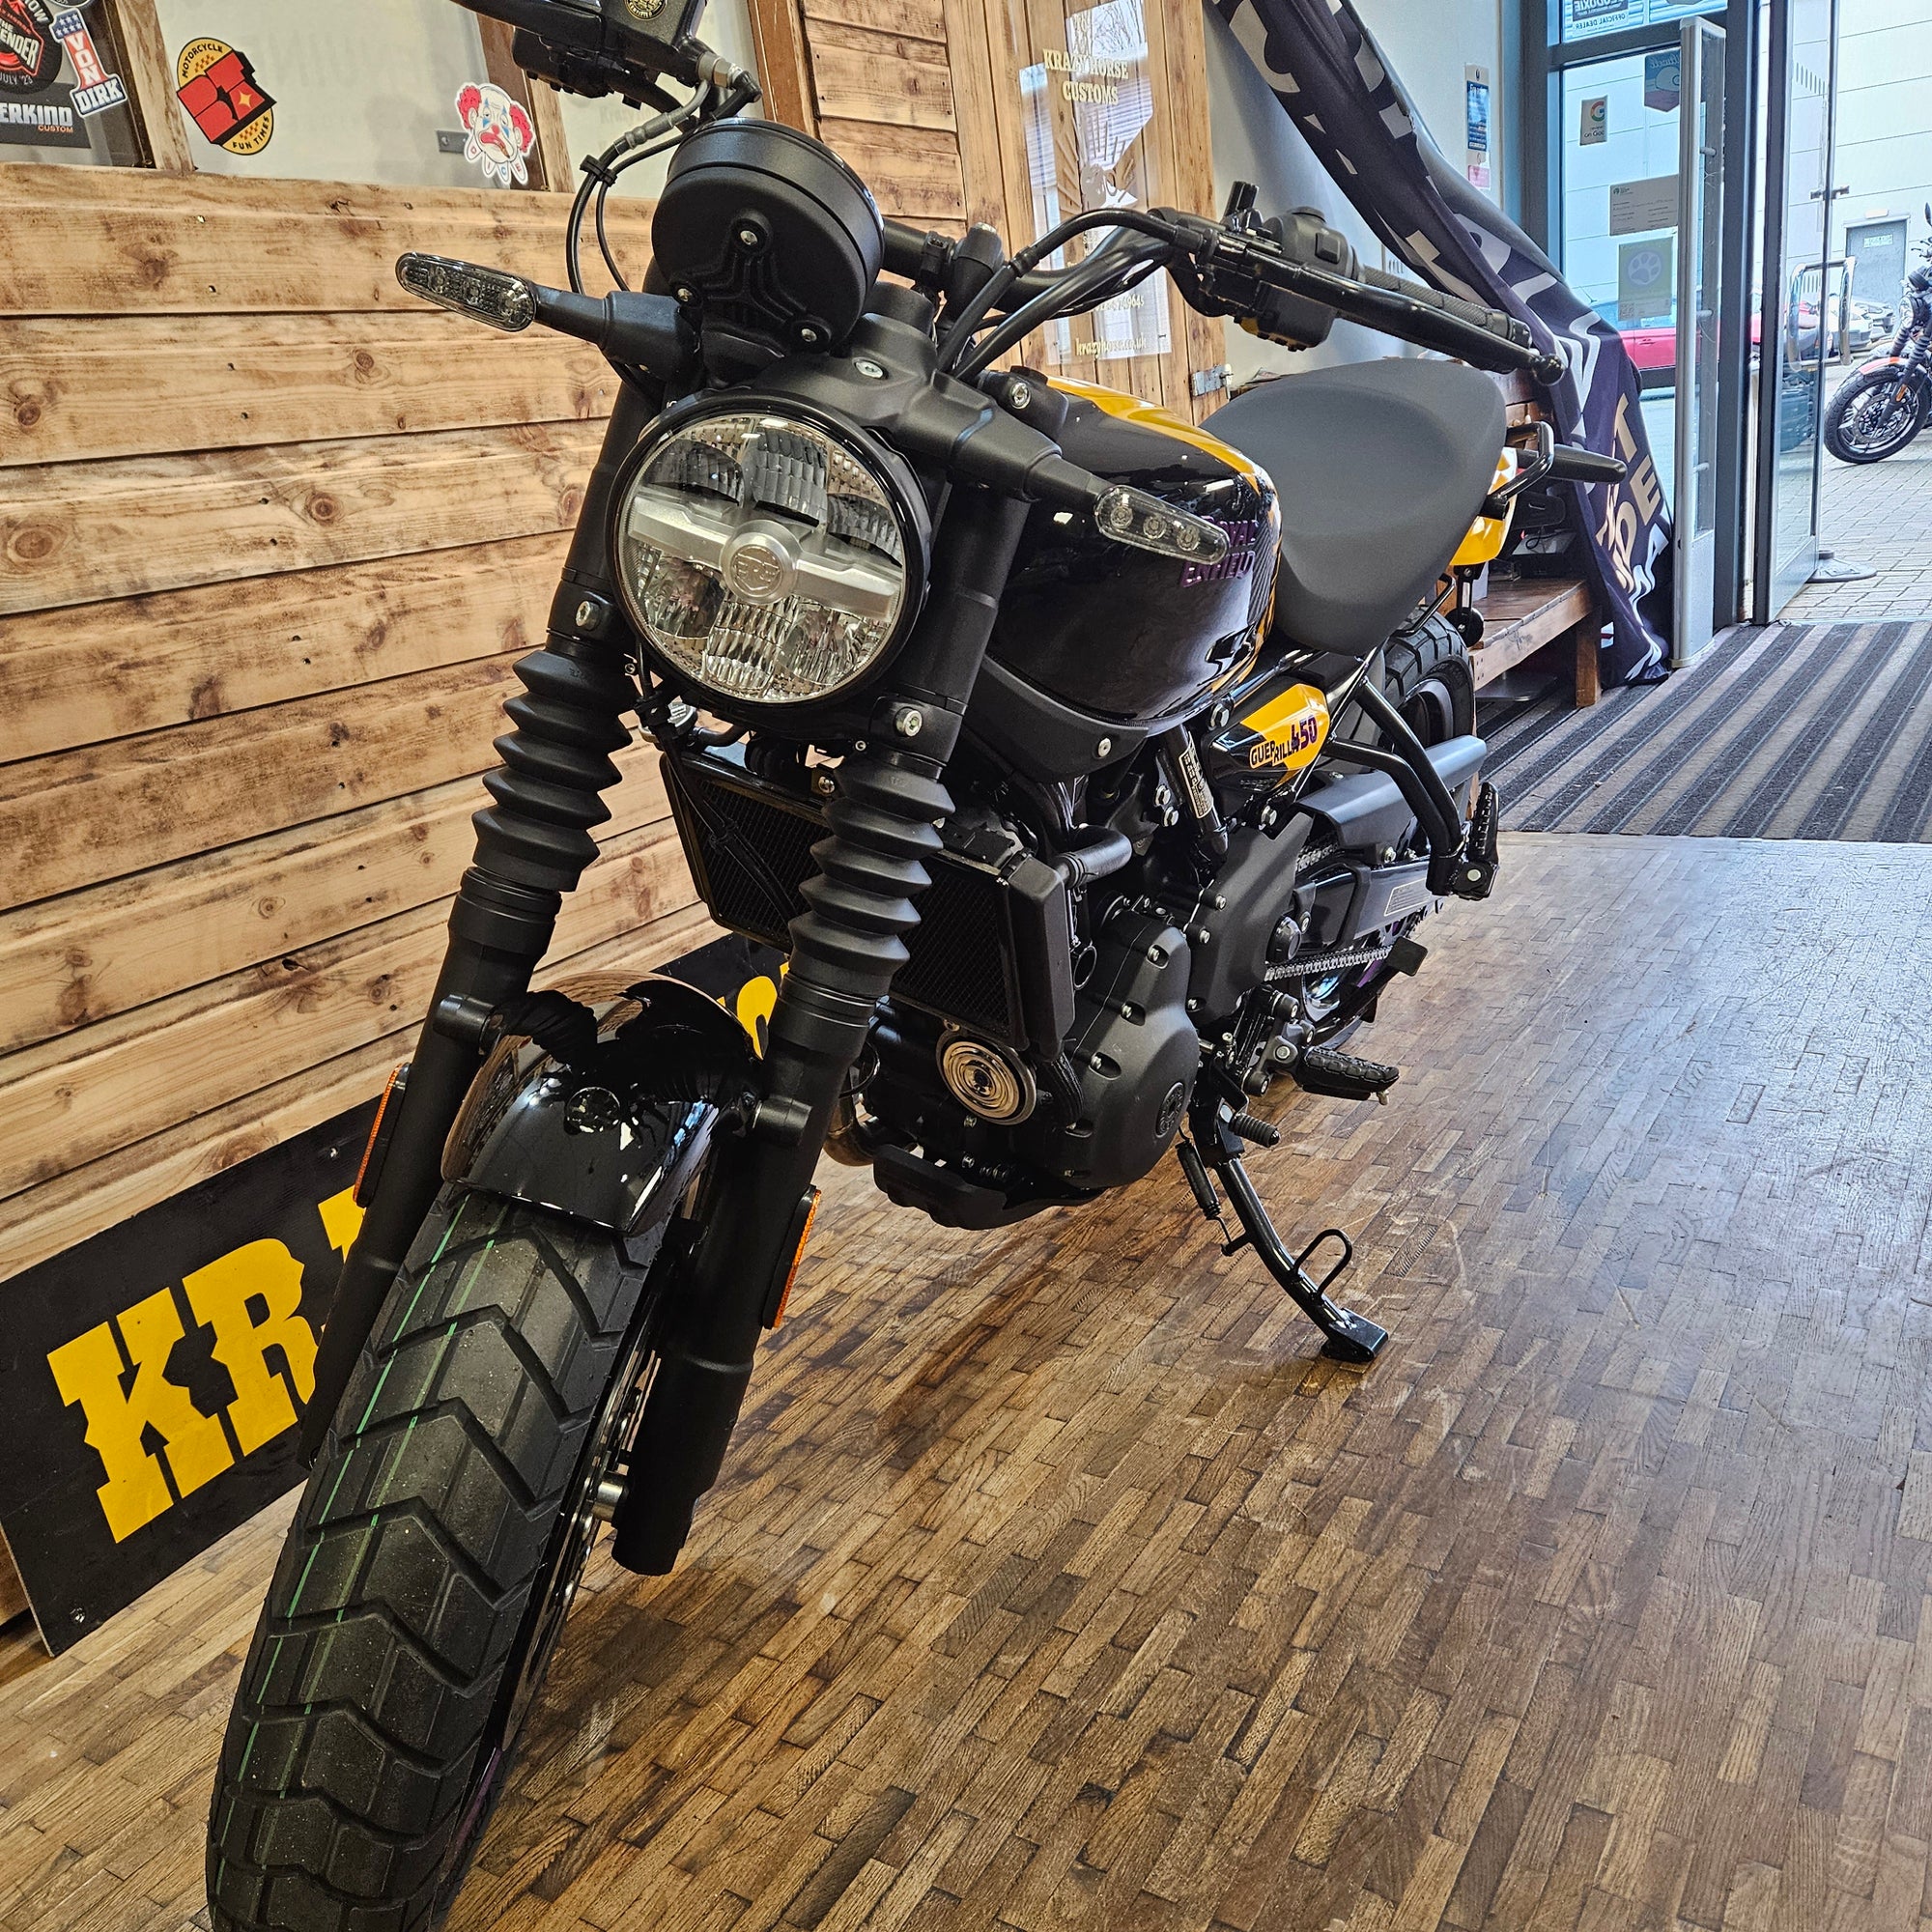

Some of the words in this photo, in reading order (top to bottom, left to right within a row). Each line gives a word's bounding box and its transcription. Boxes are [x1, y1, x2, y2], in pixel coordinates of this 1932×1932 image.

[65, 32, 101, 87] VON
[182, 43, 223, 78] MOTORCYCLE
[1043, 49, 1091, 73] KRAZY
[1089, 57, 1129, 79] HORSE
[74, 81, 124, 114] DIRK
[1063, 81, 1119, 105] CUSTOMS
[38, 125, 73, 133] CUSTOM
[232, 141, 253, 150] FUN
[253, 115, 270, 145] TIMES
